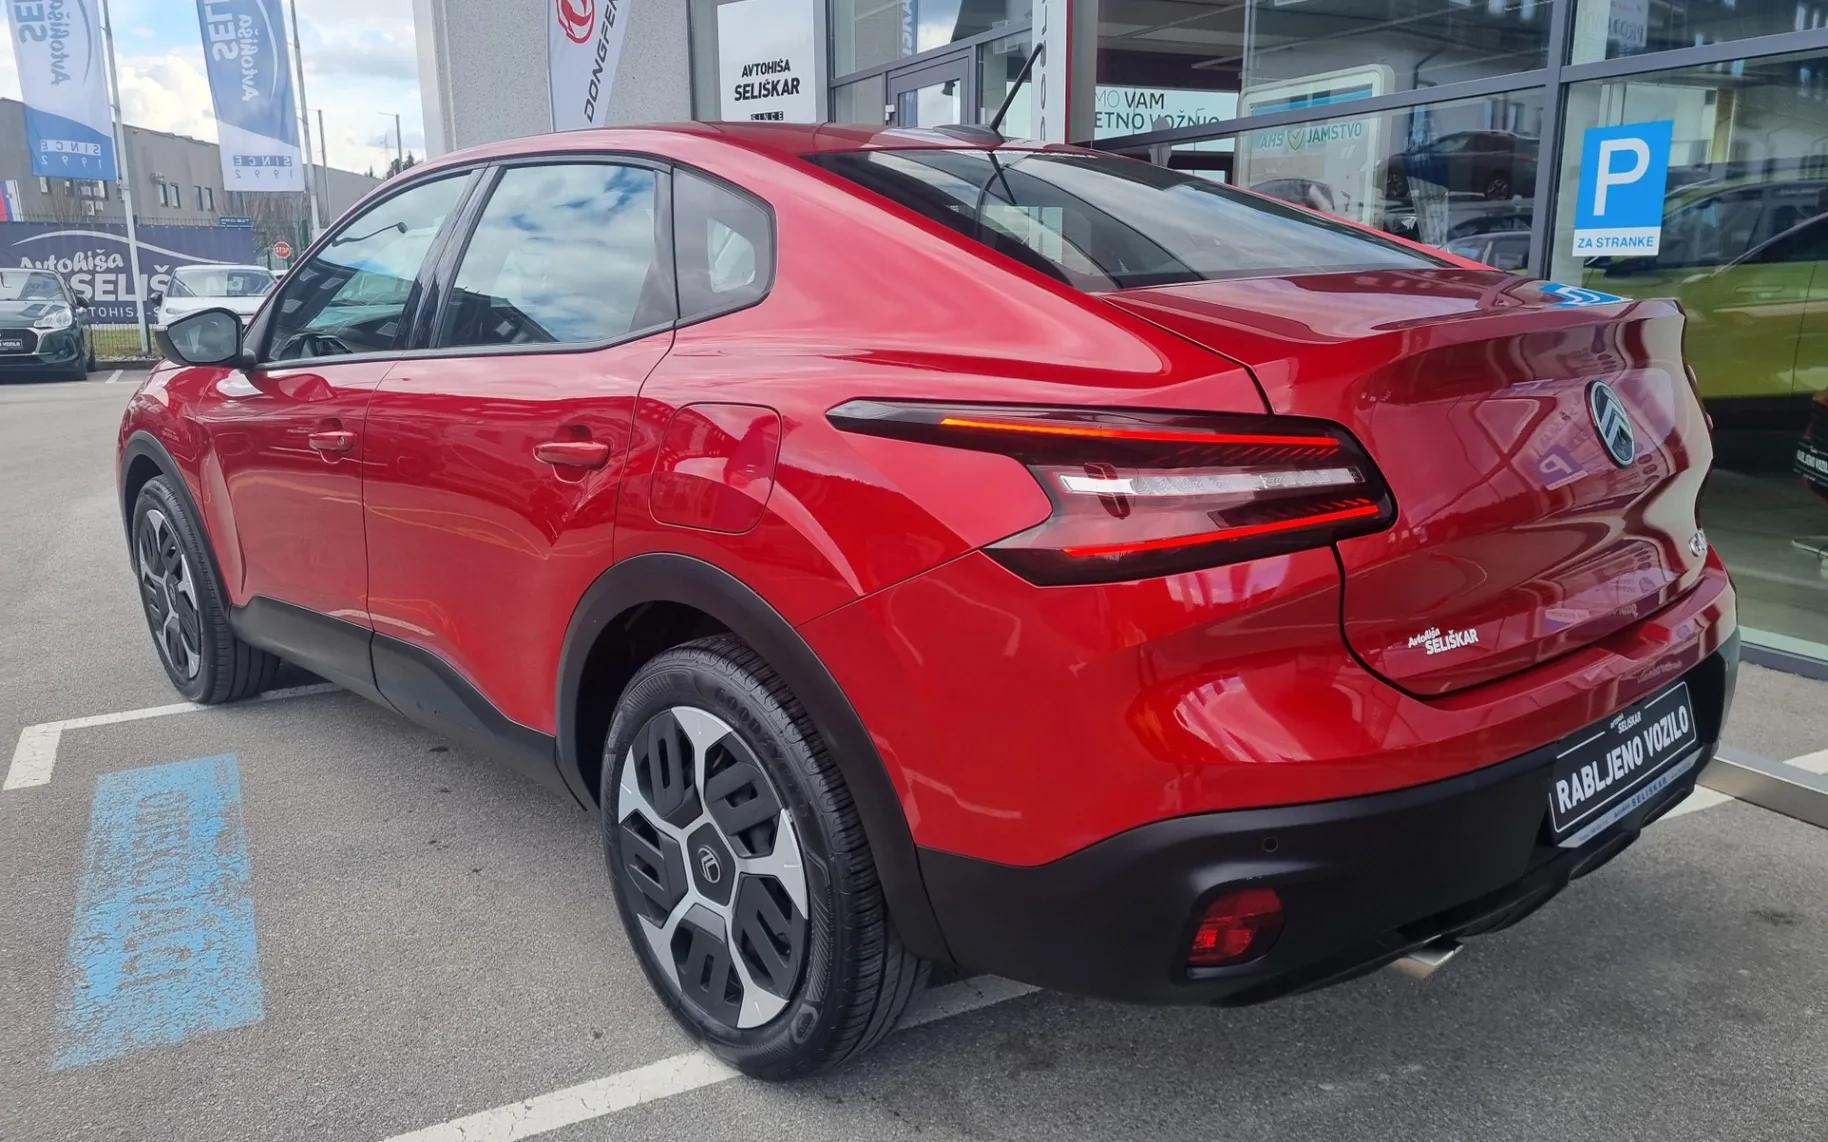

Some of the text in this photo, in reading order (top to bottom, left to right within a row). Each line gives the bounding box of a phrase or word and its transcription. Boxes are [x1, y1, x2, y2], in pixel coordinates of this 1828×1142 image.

[741, 58, 790, 78] AVTOHIŠA
[734, 77, 801, 101] SELIŠKAR
[1124, 91, 1165, 109] VAM
[1094, 112, 1145, 130] ETNO
[1307, 122, 1362, 143] JAMSTVO
[1593, 138, 1650, 216] P
[1578, 236, 1654, 248] ZA STRANKE
[20, 249, 124, 273] Avtohiša
[1425, 629, 1479, 655] SELIŠKAR
[1556, 705, 1689, 814] RABLJENO VOZILO
